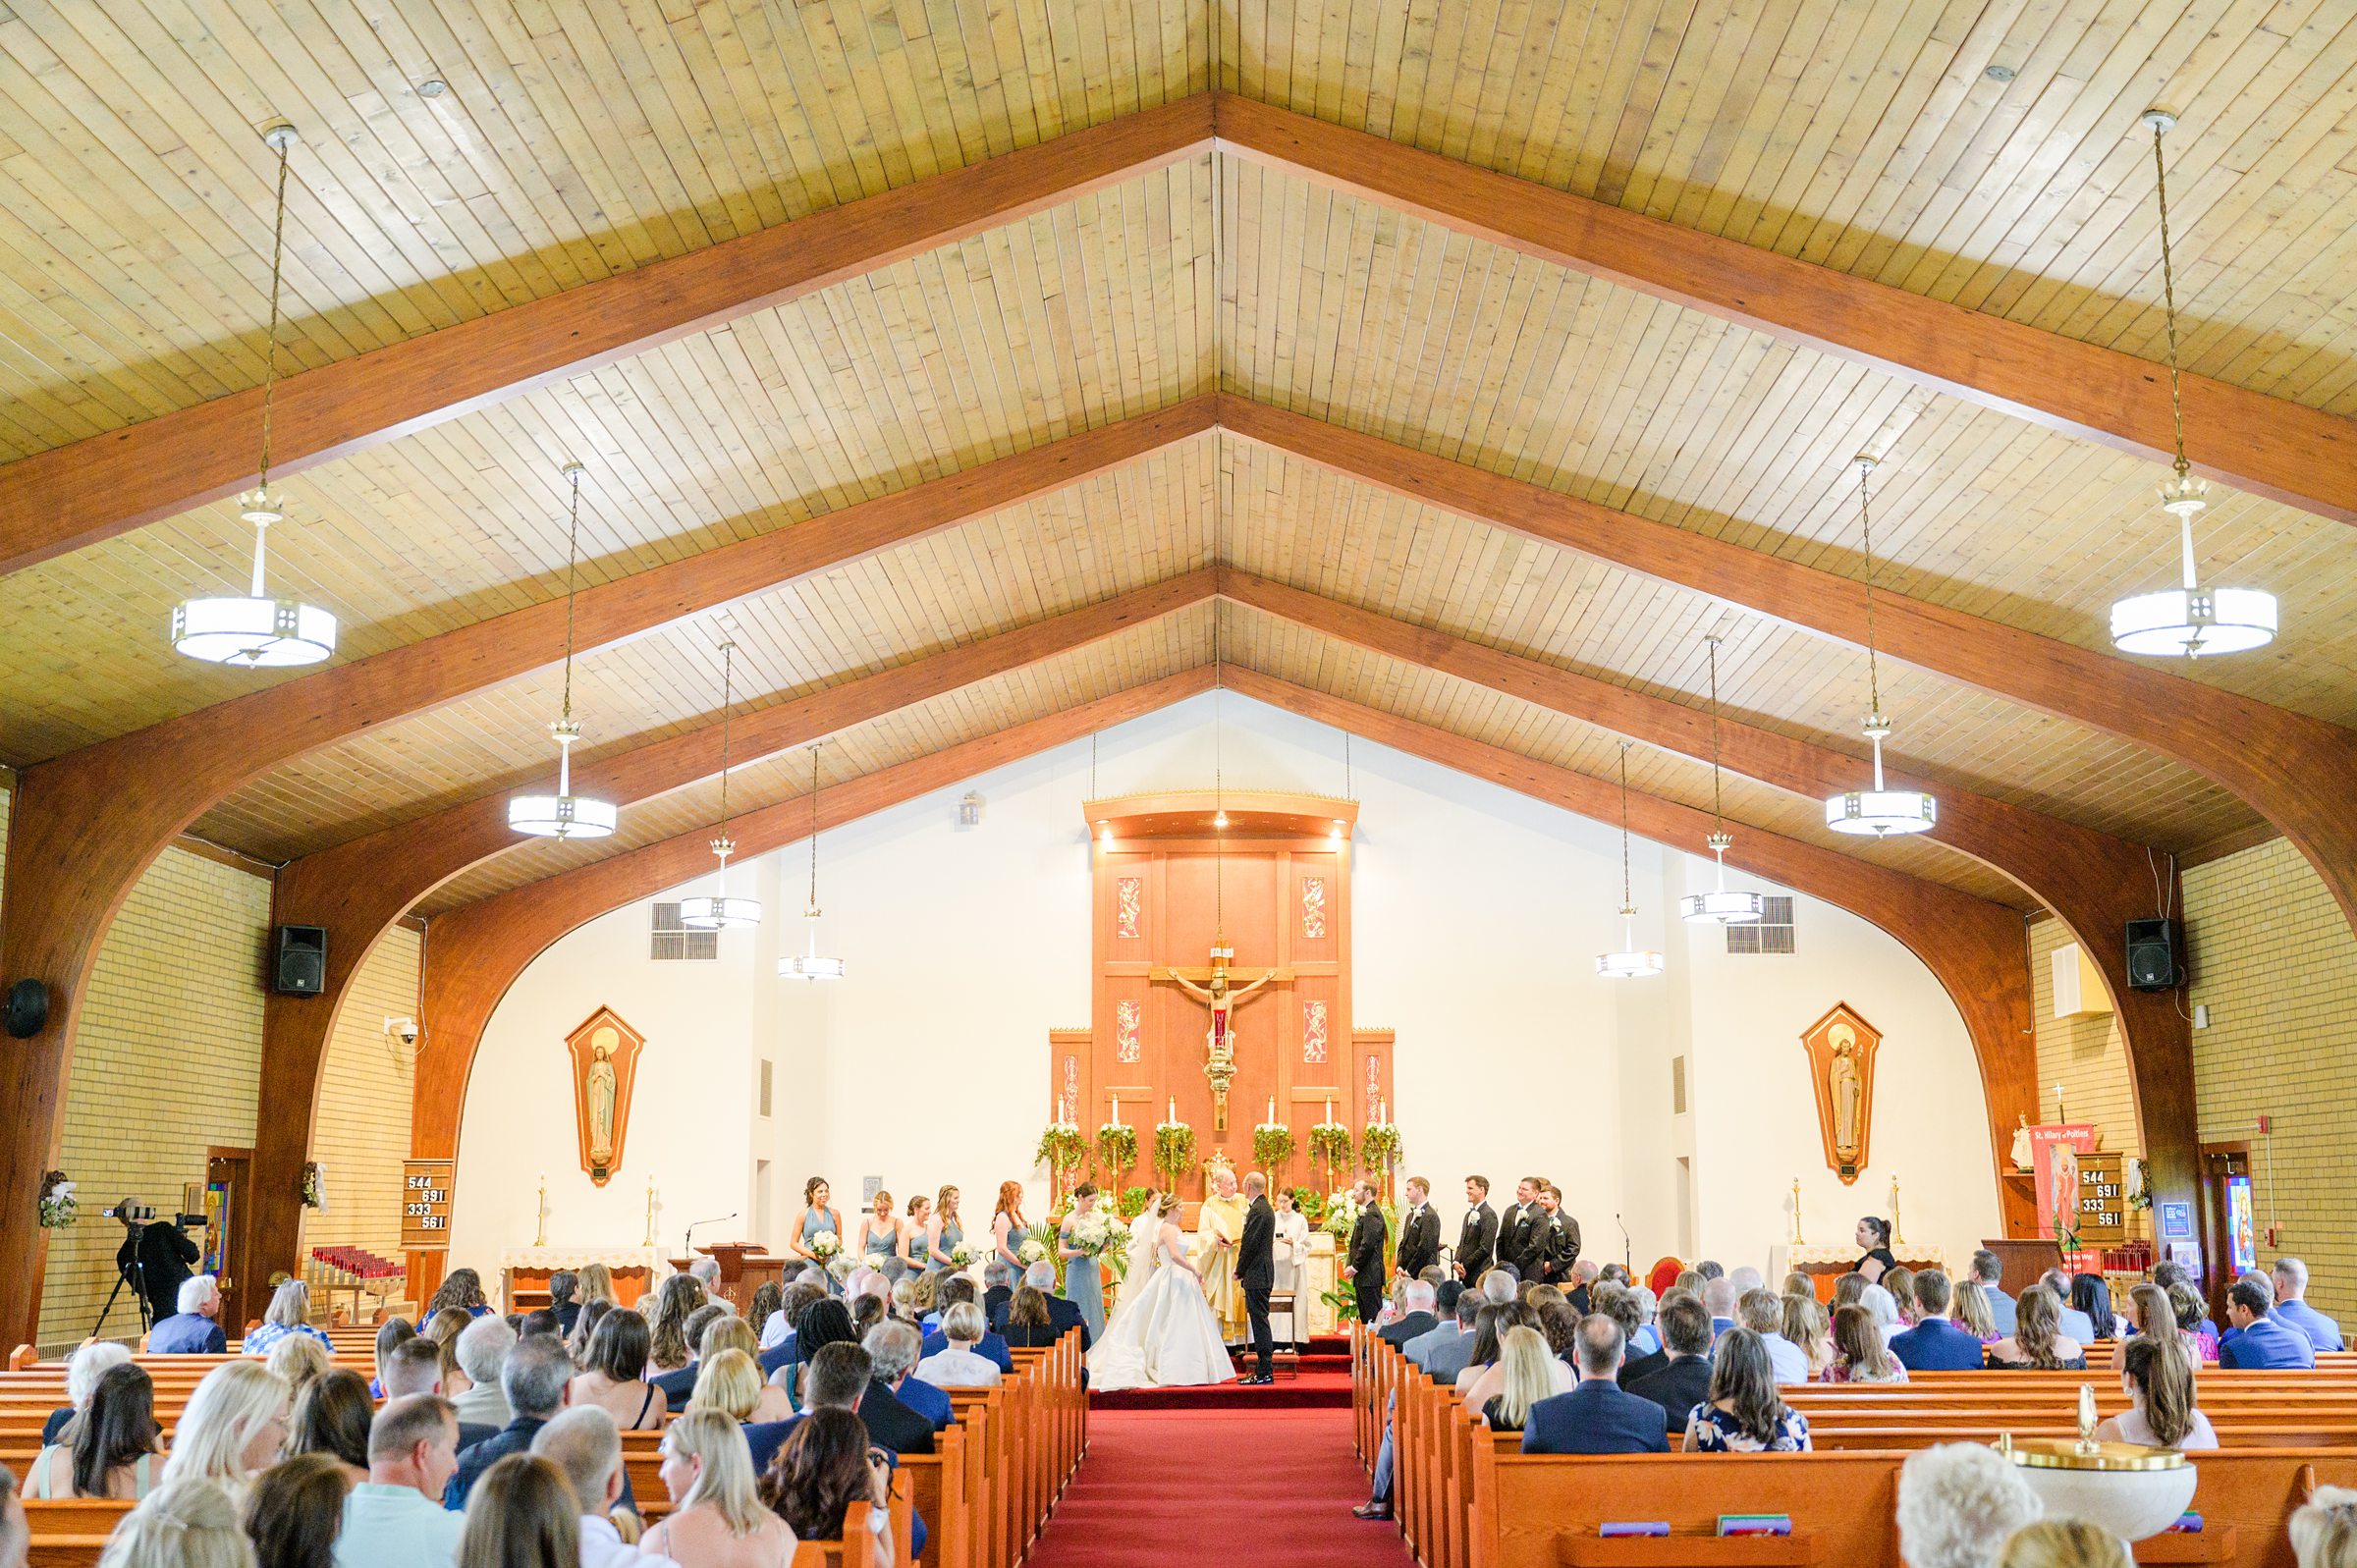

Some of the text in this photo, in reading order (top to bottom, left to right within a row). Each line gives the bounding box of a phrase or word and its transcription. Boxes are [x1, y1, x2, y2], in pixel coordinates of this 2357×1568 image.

[2044, 1130, 2061, 1140] Hilary
[2066, 1129, 2089, 1138] Poitiers
[408, 1176, 432, 1189] 544
[2082, 1170, 2105, 1183] 544
[422, 1190, 444, 1202] 691
[2097, 1184, 2117, 1197] 691
[408, 1203, 431, 1215] 333
[2083, 1199, 2105, 1211] 333
[422, 1217, 444, 1228] 561
[2098, 1213, 2118, 1225] 561
